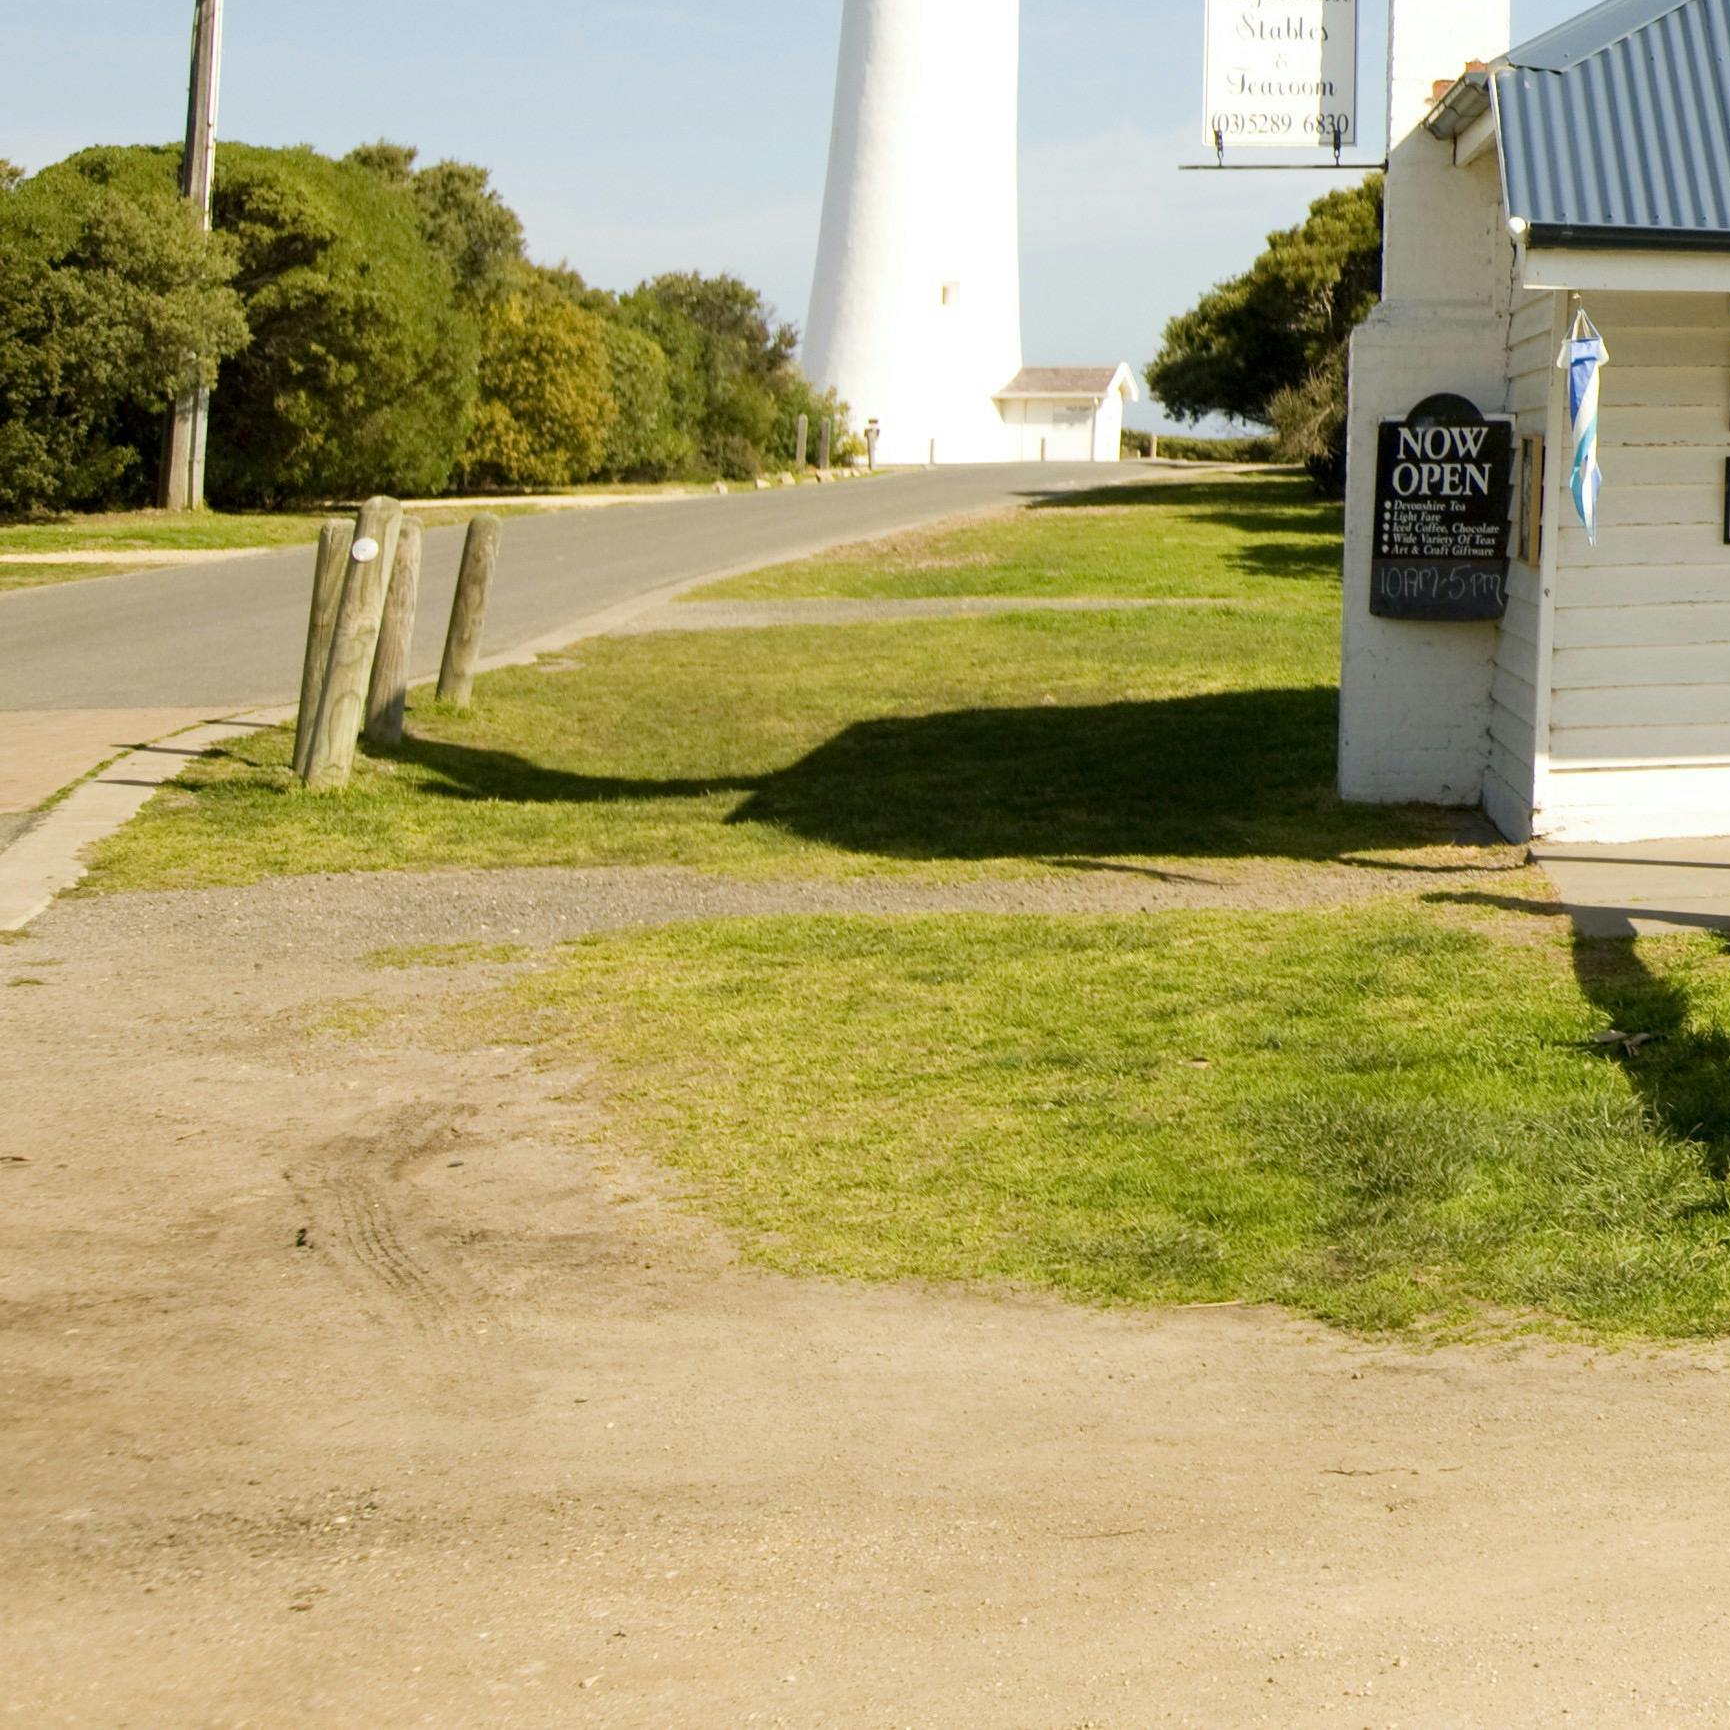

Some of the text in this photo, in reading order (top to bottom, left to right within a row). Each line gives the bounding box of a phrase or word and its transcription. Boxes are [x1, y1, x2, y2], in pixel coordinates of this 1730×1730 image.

[1236, 13, 1328, 41] Stables
[1226, 67, 1336, 97] Tearoom
[1303, 113, 1349, 135] 6830
[1397, 427, 1488, 460] NOW
[1392, 463, 1492, 496] OPEN
[1394, 499, 1466, 512] Devonshire Tea
[1393, 511, 1441, 523] Light Fare
[1393, 522, 1412, 532] Iced
[1452, 522, 1500, 534] Chocolate
[1393, 533, 1496, 546] Wide Variety Of Teas
[1391, 543, 1495, 557] Art & Craft Giftware
